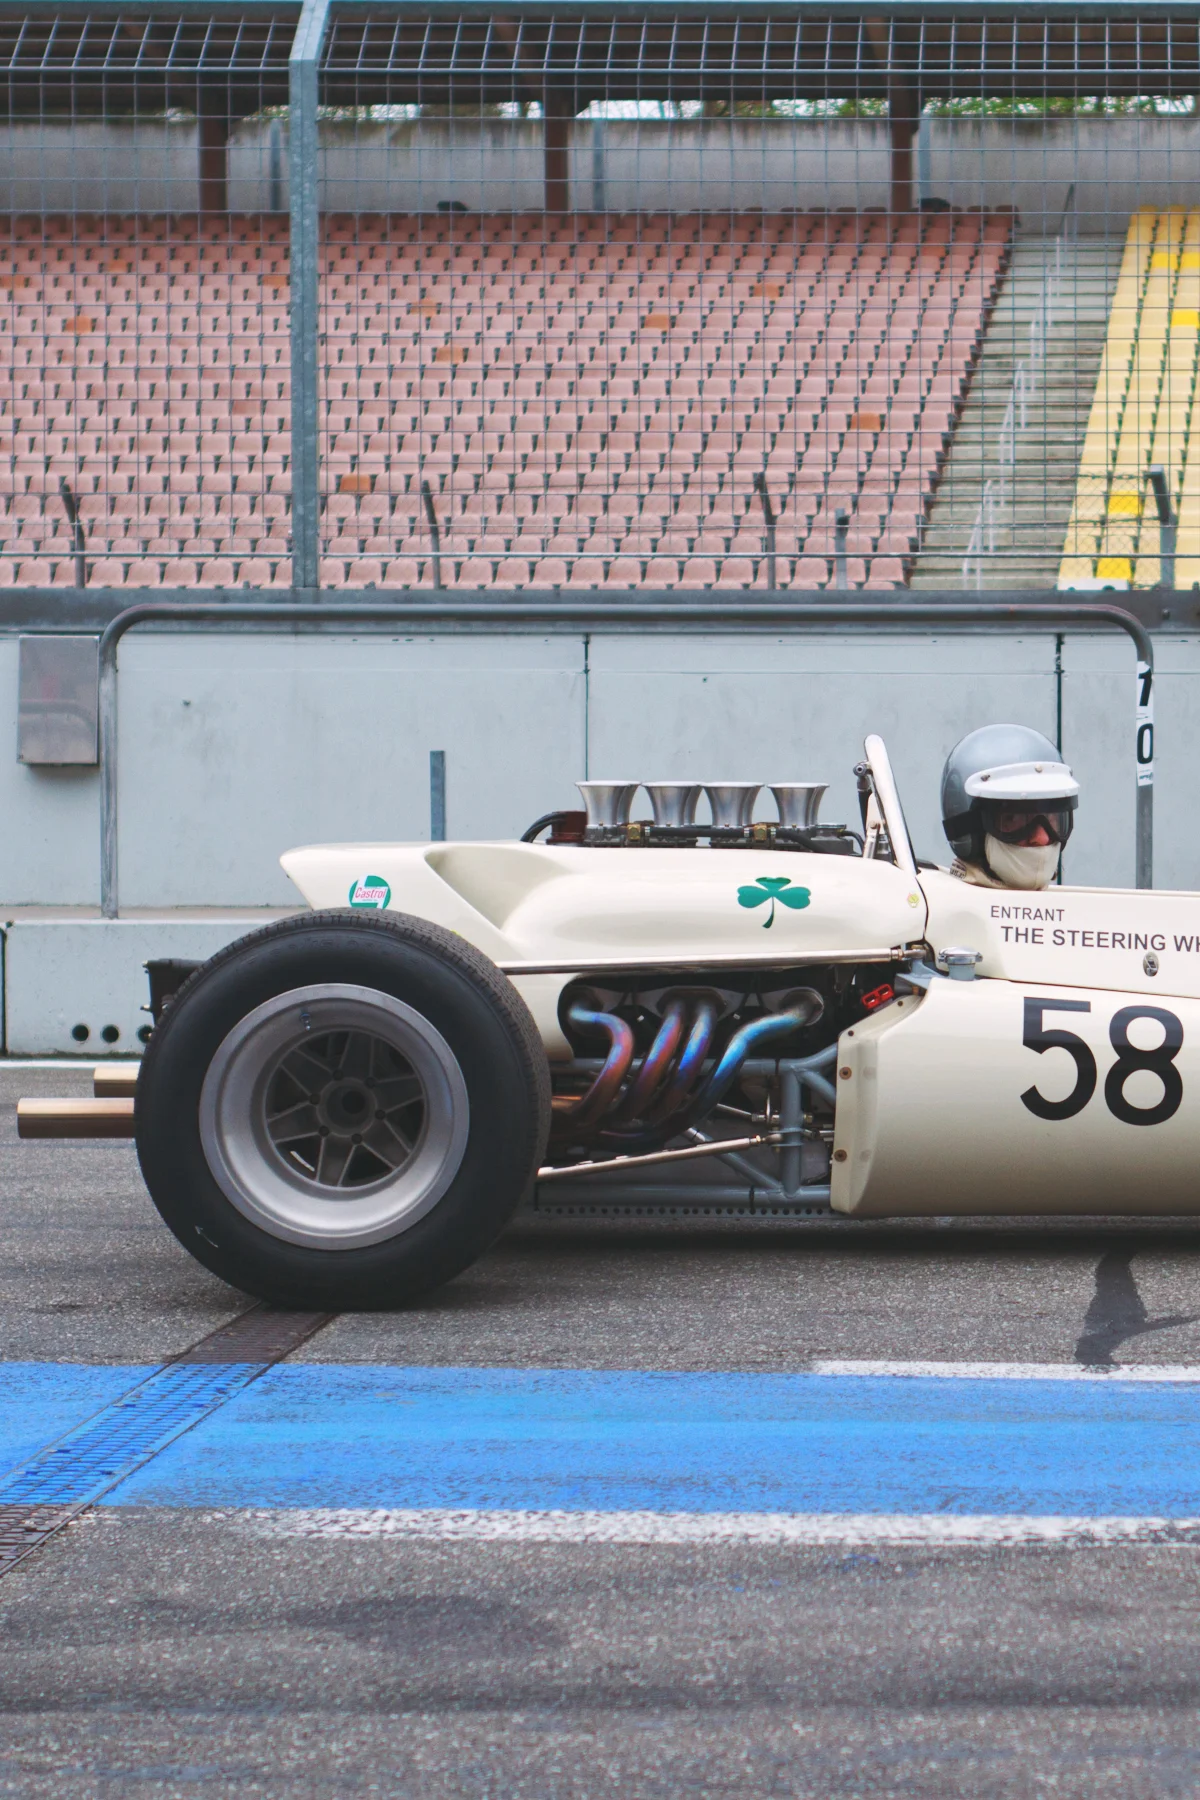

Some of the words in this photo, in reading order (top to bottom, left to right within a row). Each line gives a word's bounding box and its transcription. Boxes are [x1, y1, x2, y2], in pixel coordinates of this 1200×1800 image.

[355, 887, 387, 899] Castrol
[990, 905, 1065, 922] ENTRANT
[1000, 925, 1044, 945] THE
[1052, 929, 1166, 951] STEERING
[1020, 996, 1184, 1126] 58
